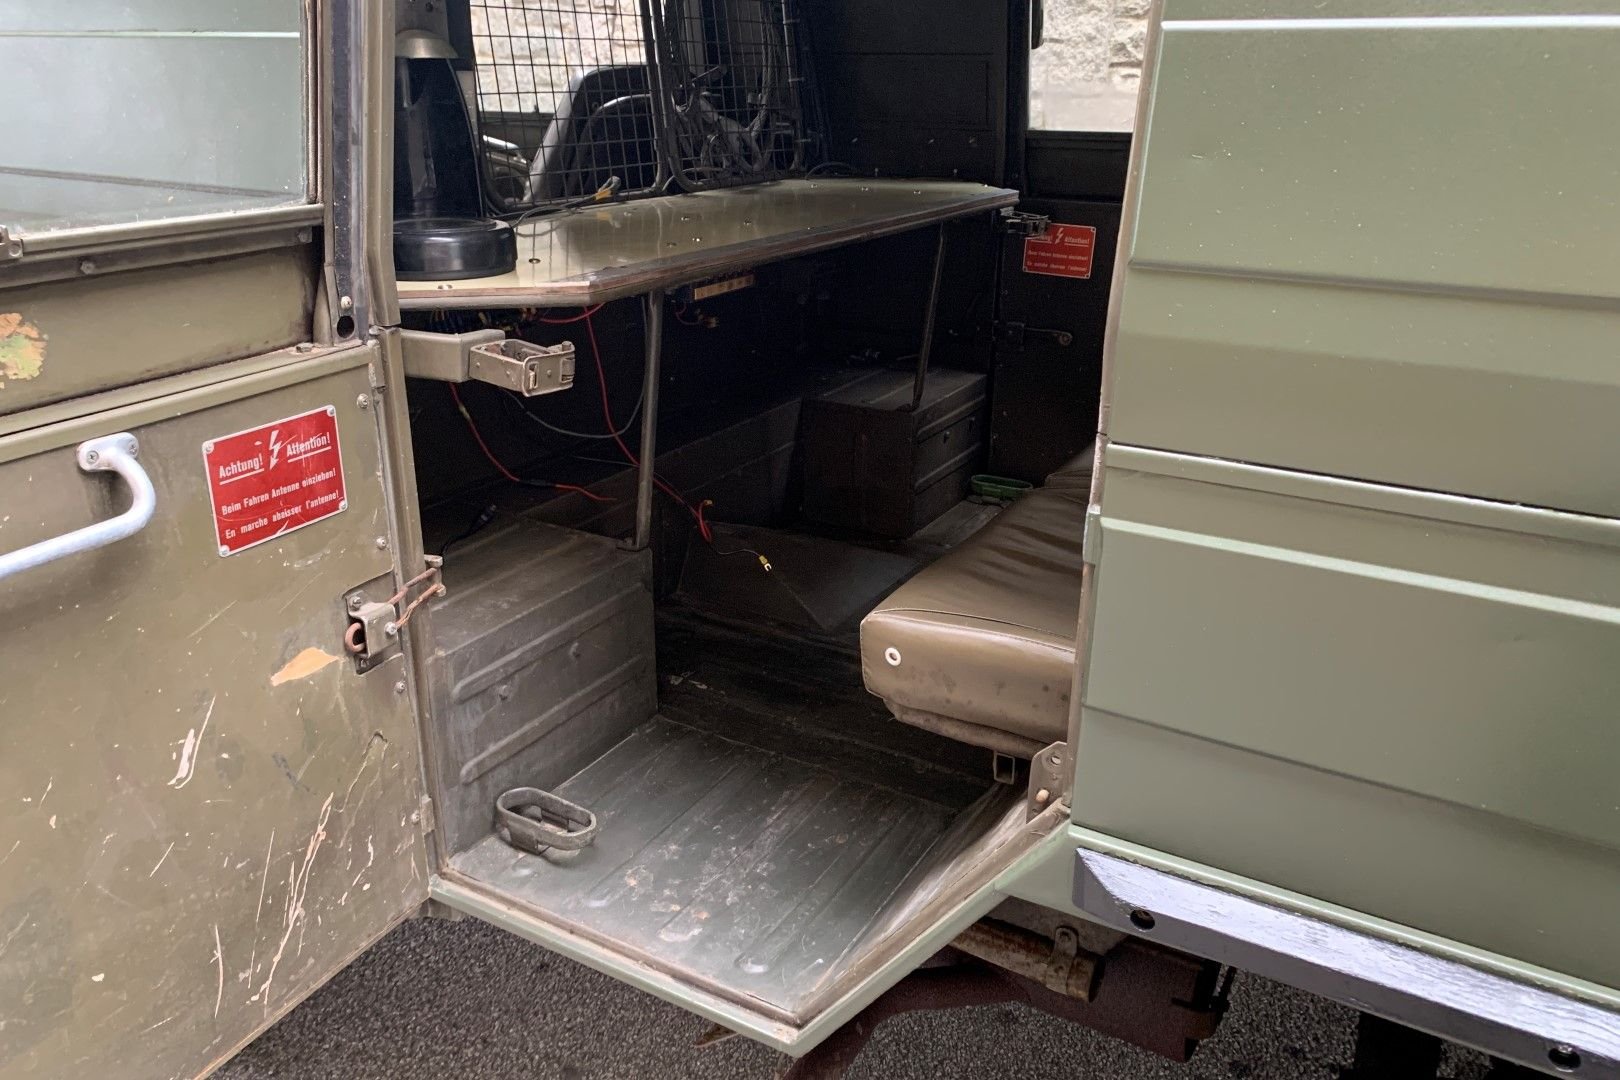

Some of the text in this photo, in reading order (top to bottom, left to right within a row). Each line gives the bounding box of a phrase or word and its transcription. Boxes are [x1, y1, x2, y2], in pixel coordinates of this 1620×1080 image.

[219, 431, 331, 479] Achtung! Attention!
[222, 467, 336, 515] Beim Fahren Antenne einziehen!
[225, 489, 339, 539] En marche abaisser l'antenne!
